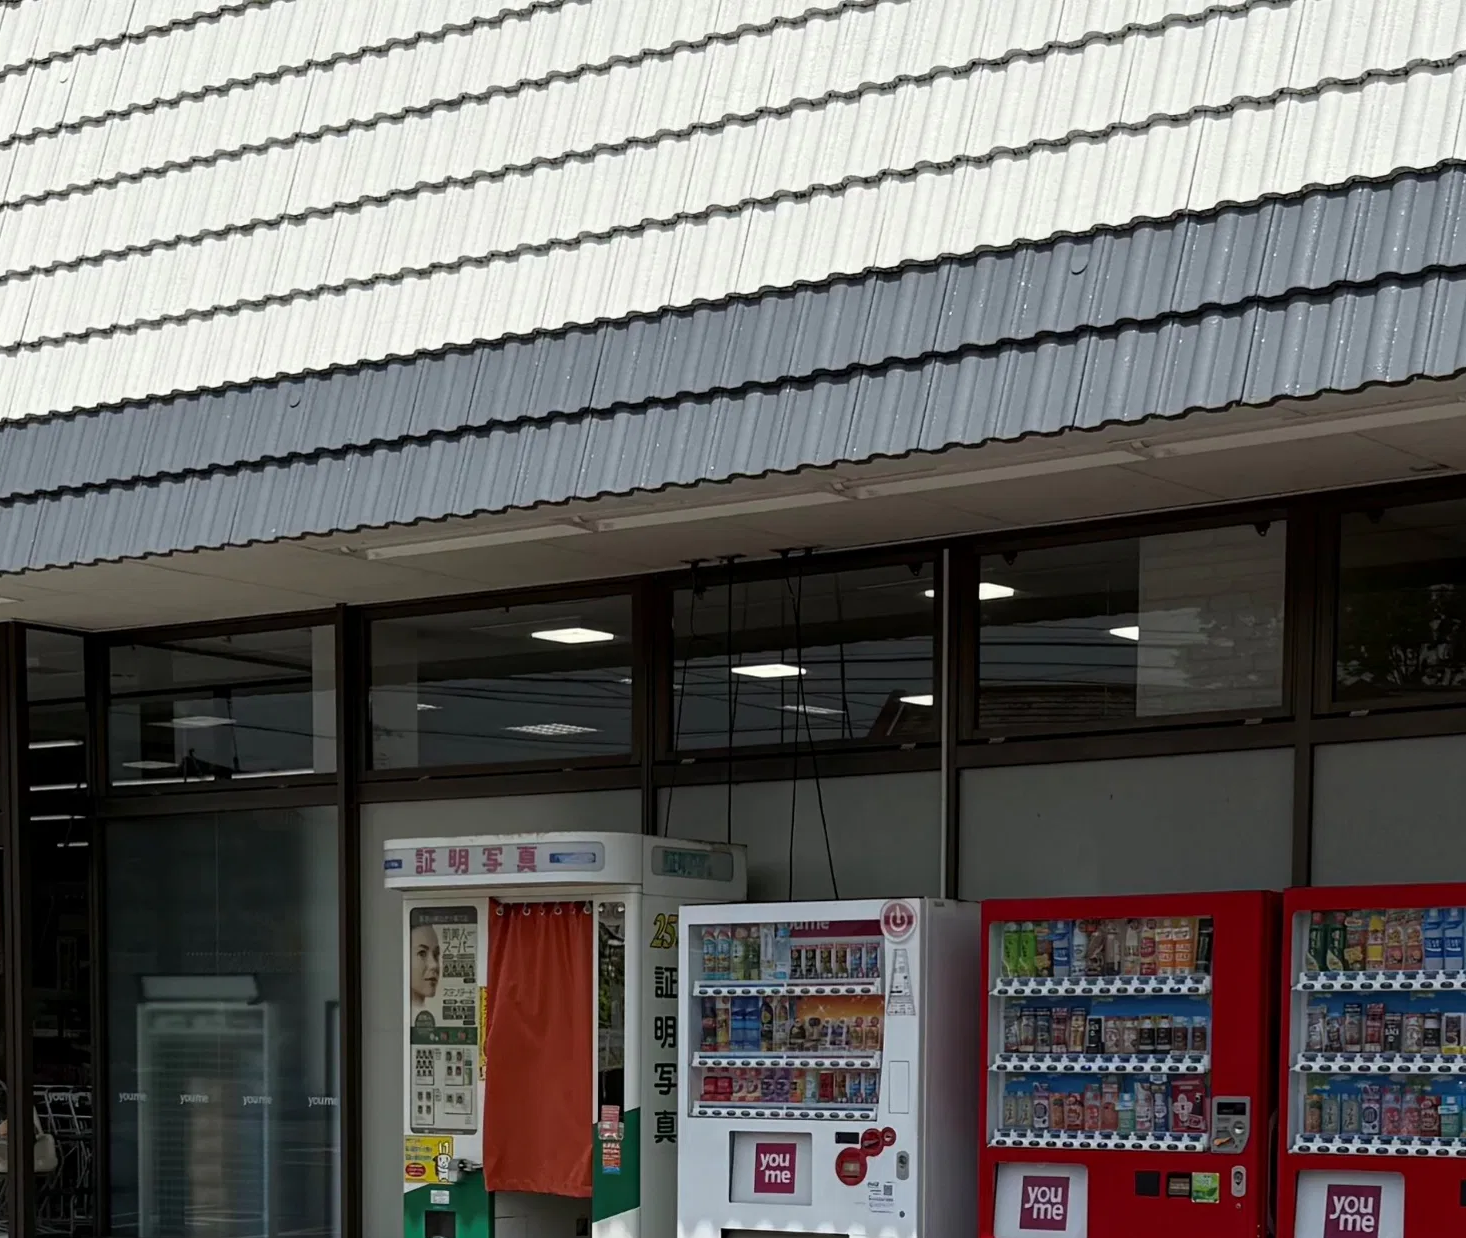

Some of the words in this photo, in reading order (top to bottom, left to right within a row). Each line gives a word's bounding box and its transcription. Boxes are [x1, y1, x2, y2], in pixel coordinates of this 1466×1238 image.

[415, 846, 538, 875] 証明写真
[649, 912, 679, 950] 25
[654, 965, 678, 1144] 証明写真
[760, 1153, 790, 1170] you
[764, 1169, 791, 1183] me
[1024, 1185, 1062, 1209] you
[1329, 1195, 1374, 1219] you
[1032, 1203, 1064, 1220] me
[1338, 1213, 1375, 1232] me
